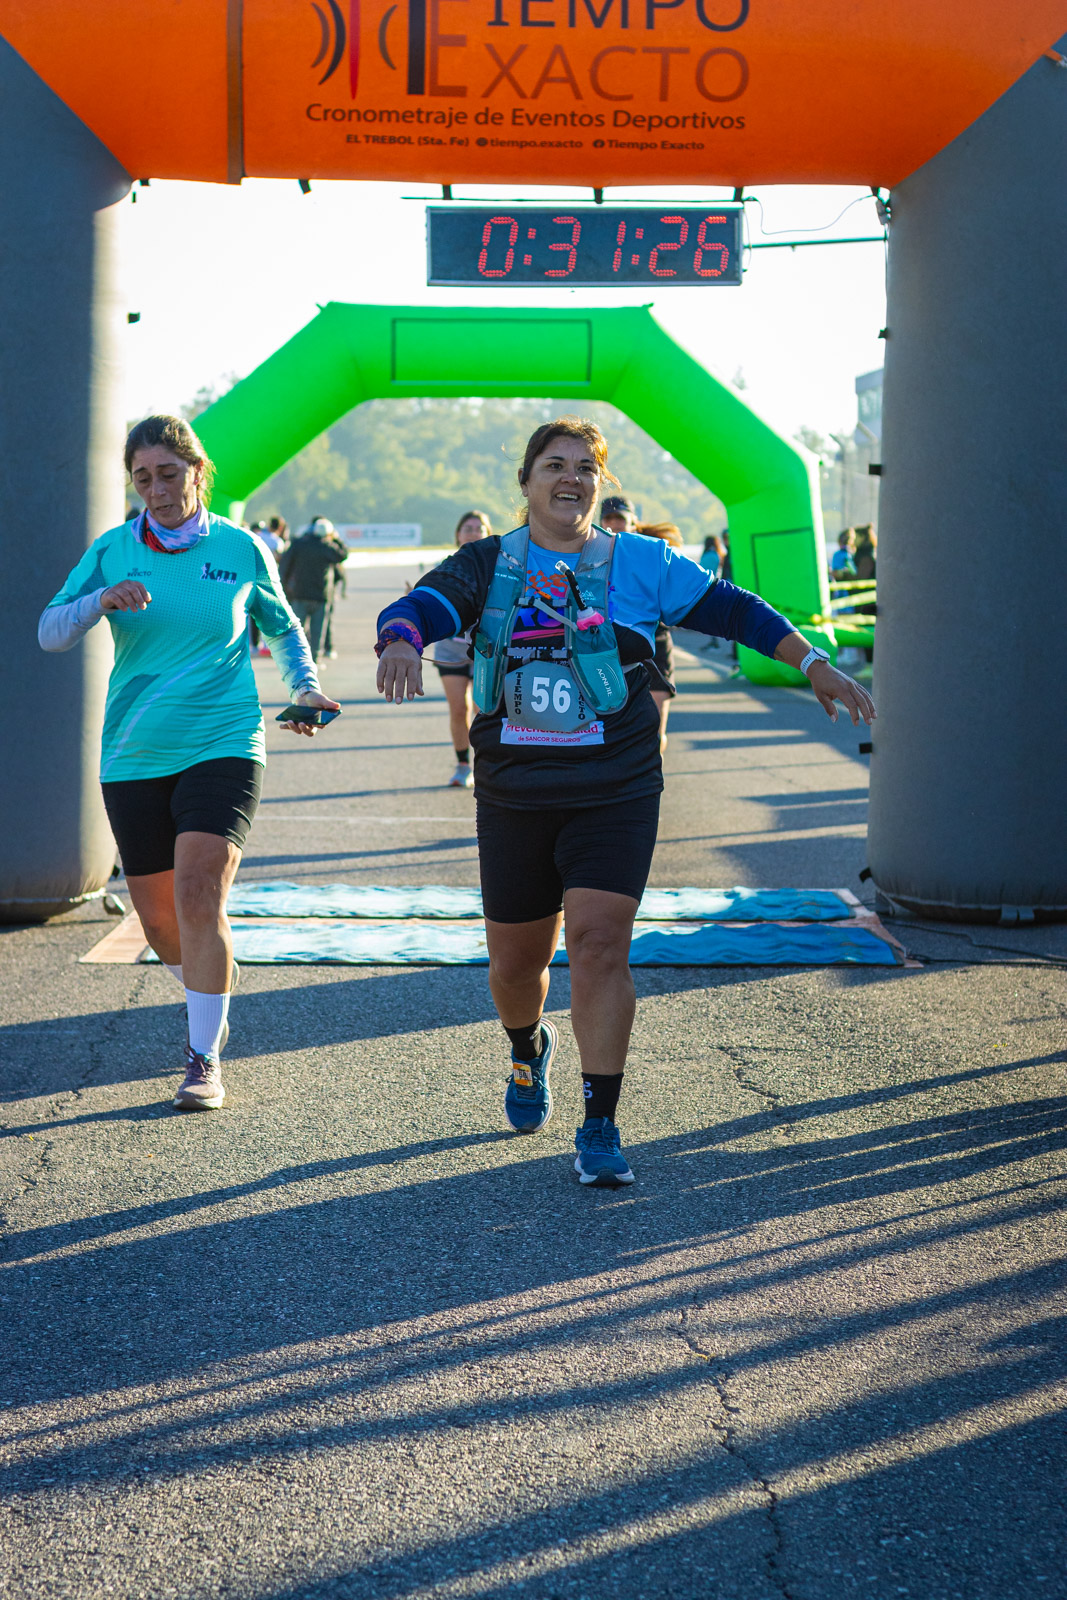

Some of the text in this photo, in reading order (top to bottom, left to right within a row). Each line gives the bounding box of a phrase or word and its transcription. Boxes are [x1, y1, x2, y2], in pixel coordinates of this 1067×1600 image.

[305, 103, 746, 132] Cronometraje de Eventos Deportivos
[346, 134, 361, 144] EL
[363, 134, 414, 145] TREBOL
[418, 135, 448, 146] (Sta.
[450, 137, 470, 147] Fe)
[606, 139, 658, 151] Tiempo
[660, 140, 705, 150] Exacto
[514, 672, 524, 715] TIEMPO
[530, 676, 572, 714] 56
[526, 735, 550, 743] SANCOR
